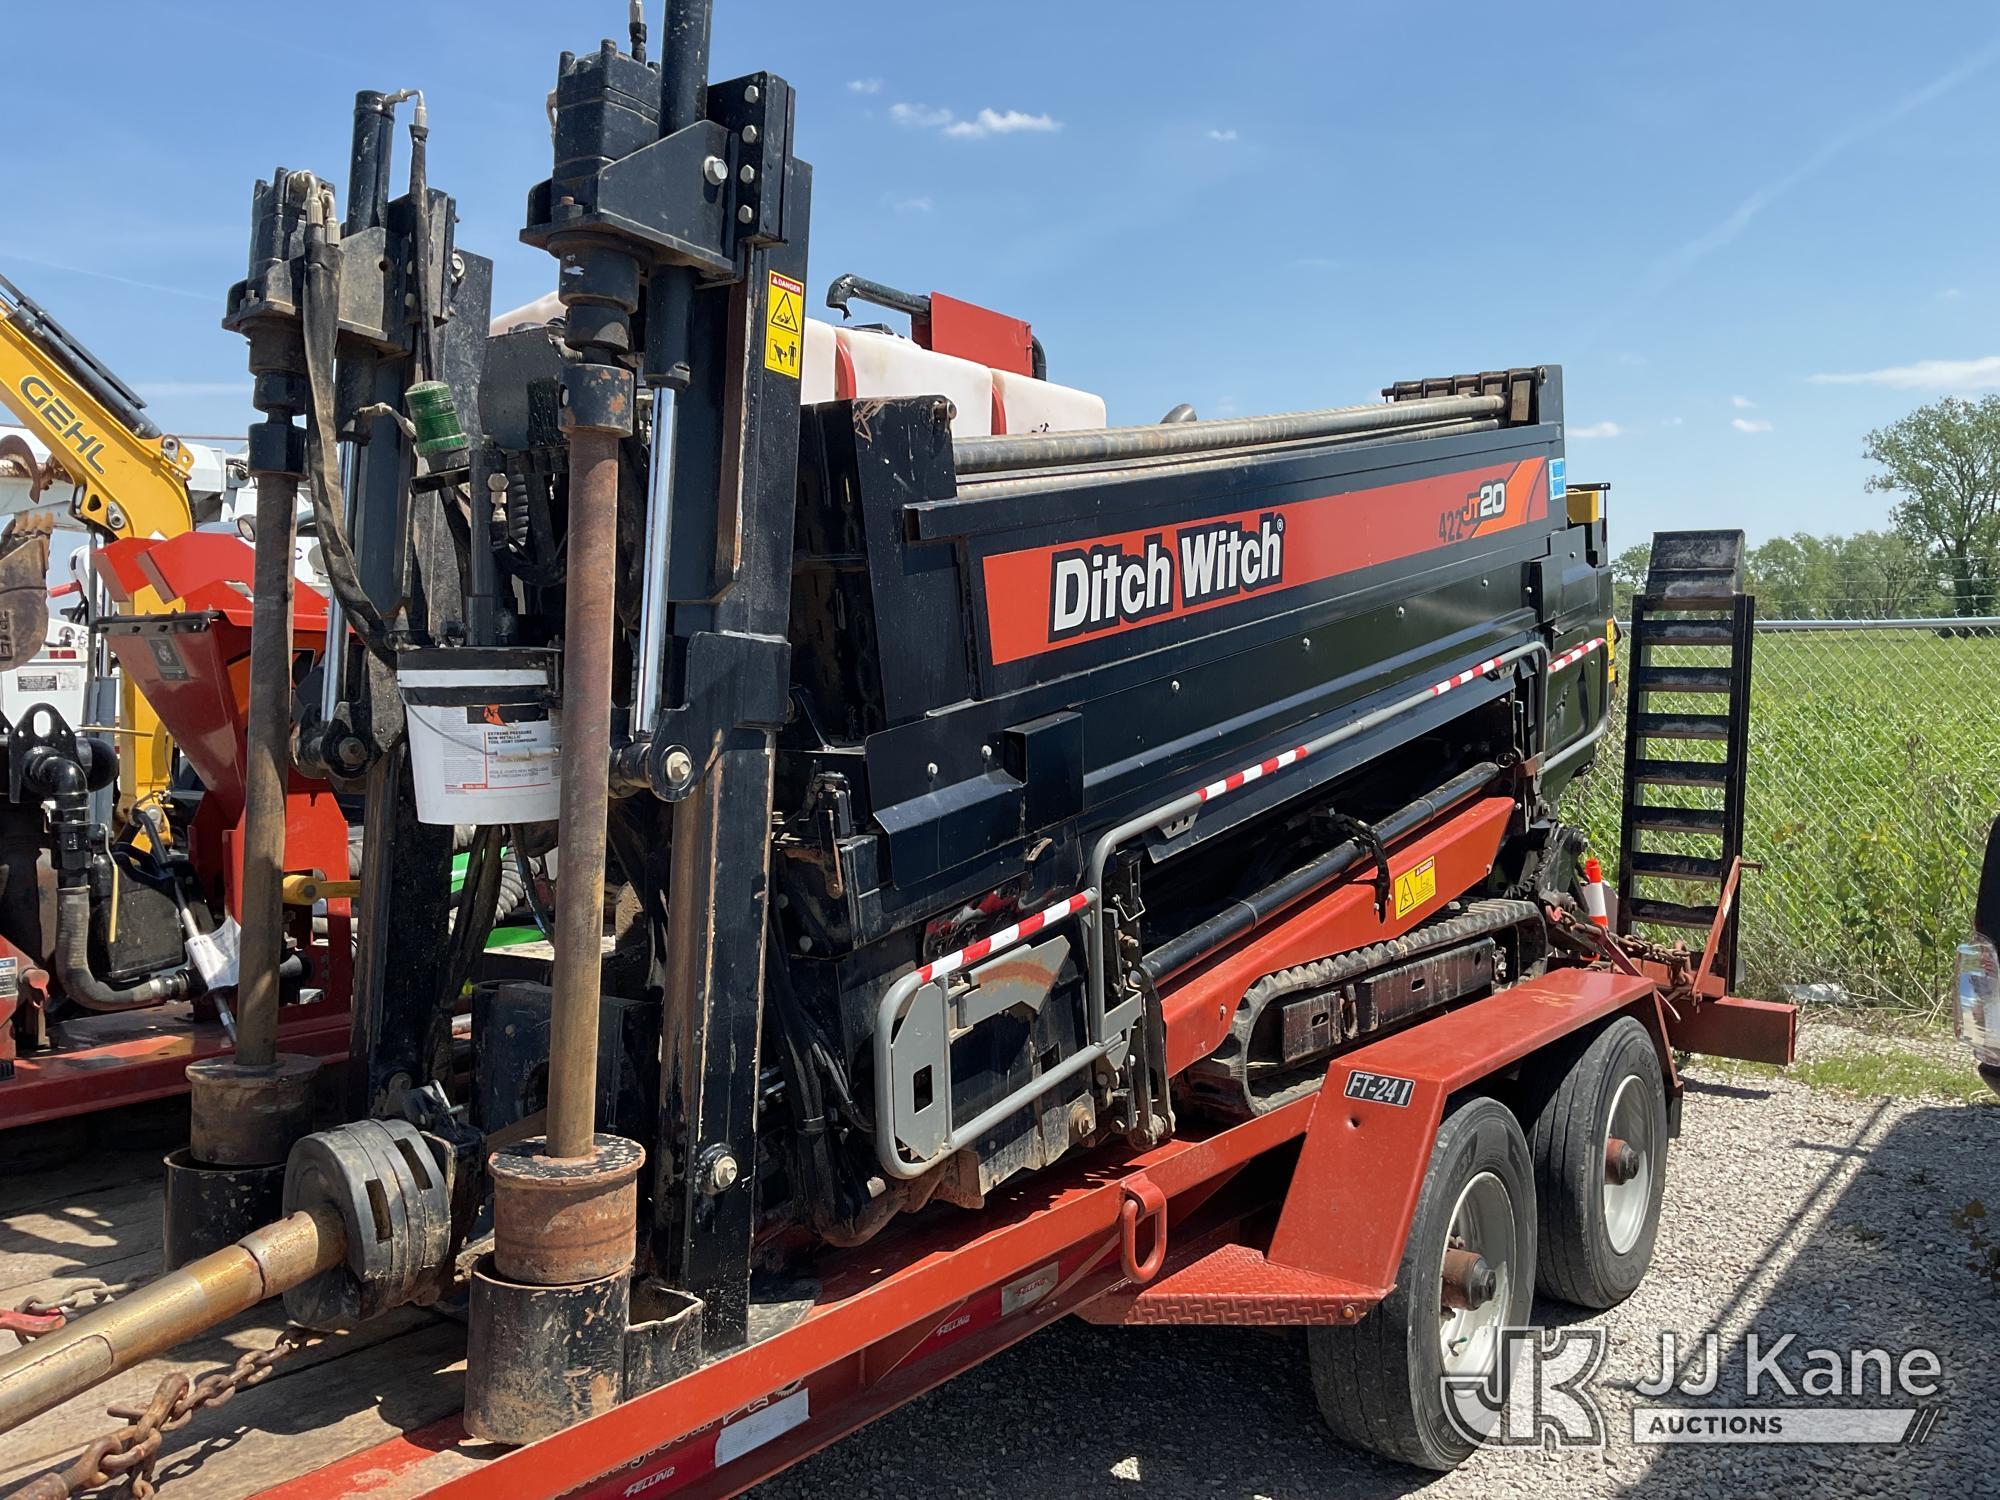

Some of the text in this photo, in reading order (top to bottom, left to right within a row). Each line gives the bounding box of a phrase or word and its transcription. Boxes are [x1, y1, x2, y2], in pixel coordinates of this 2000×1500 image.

[777, 279, 801, 294] DANGER
[19, 375, 105, 476] GEHL
[1438, 510, 1463, 544] 422
[1053, 543, 1172, 632] Ditch
[936, 1314, 971, 1336] FELLING
[623, 1466, 676, 1498] FELLING
